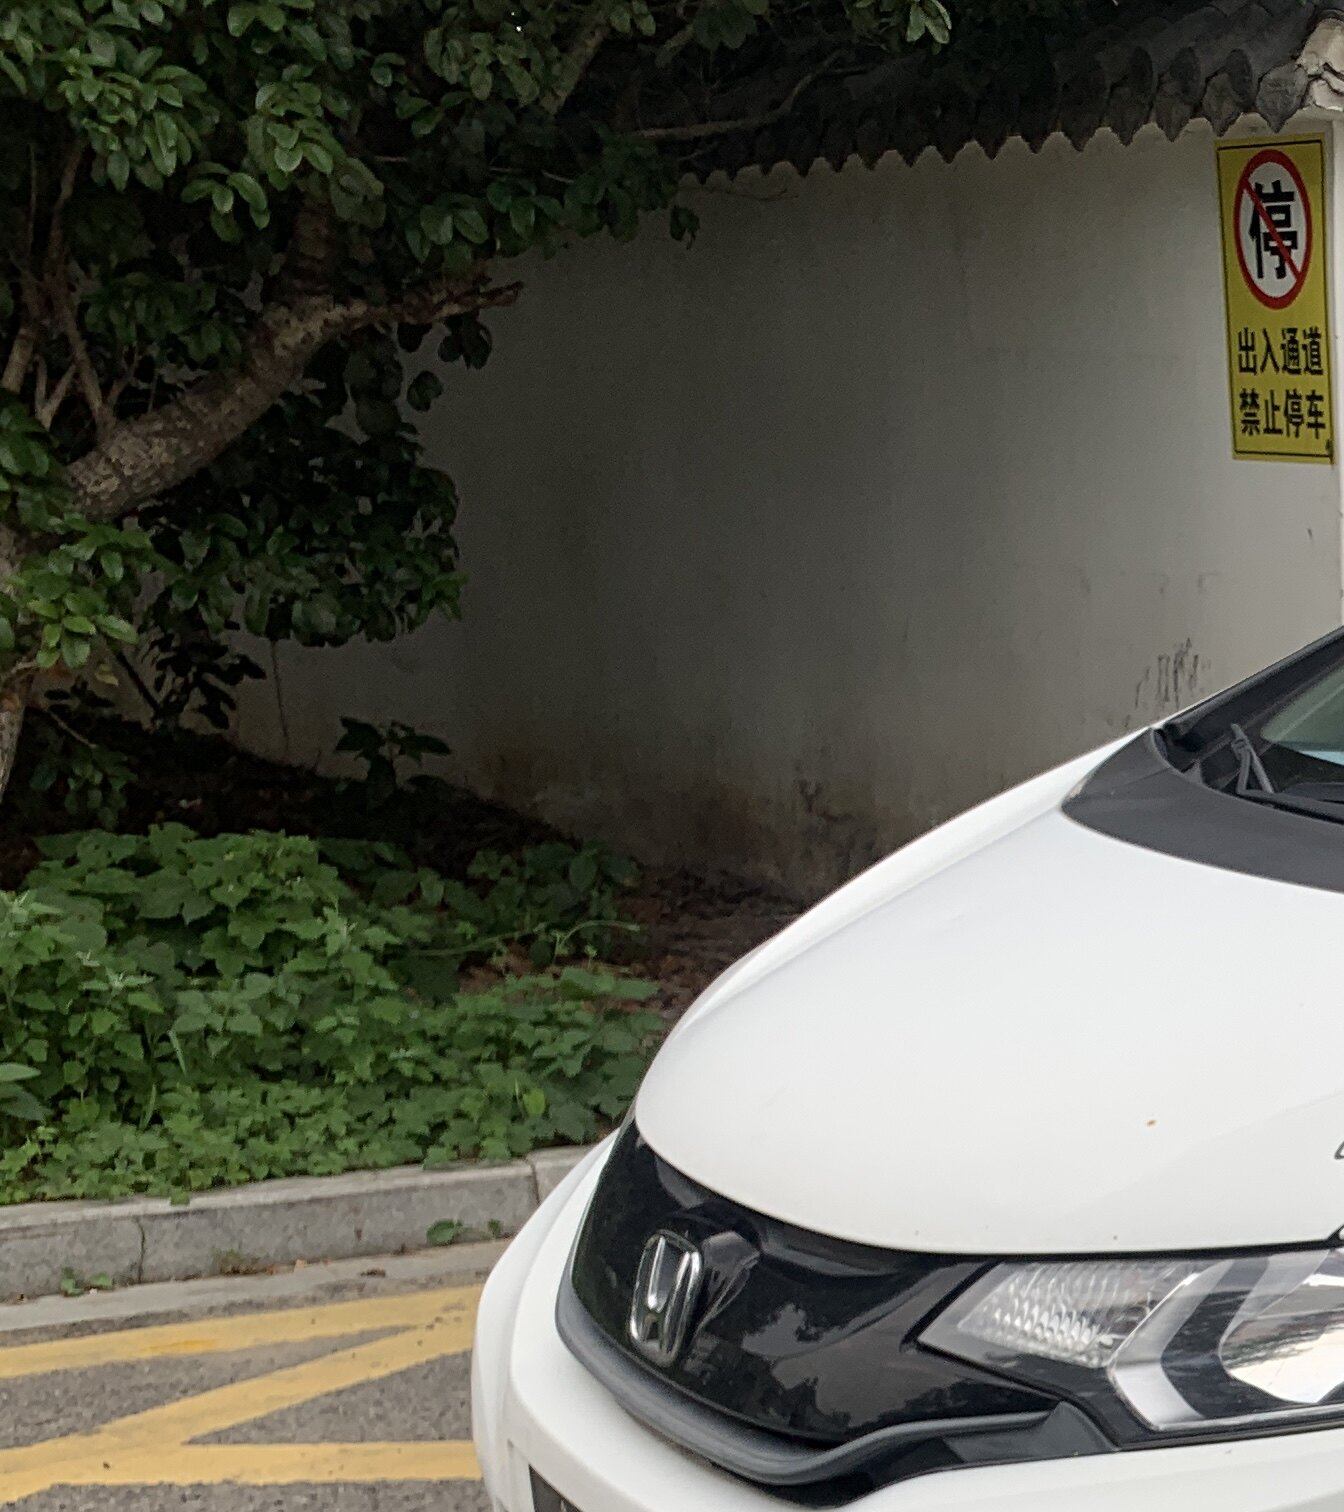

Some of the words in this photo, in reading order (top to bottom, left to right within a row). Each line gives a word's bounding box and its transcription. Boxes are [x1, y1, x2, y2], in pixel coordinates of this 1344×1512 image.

[1249, 180, 1298, 280] 停
[1238, 327, 1323, 375] 出入通道
[1239, 388, 1326, 439] 禁止停车
